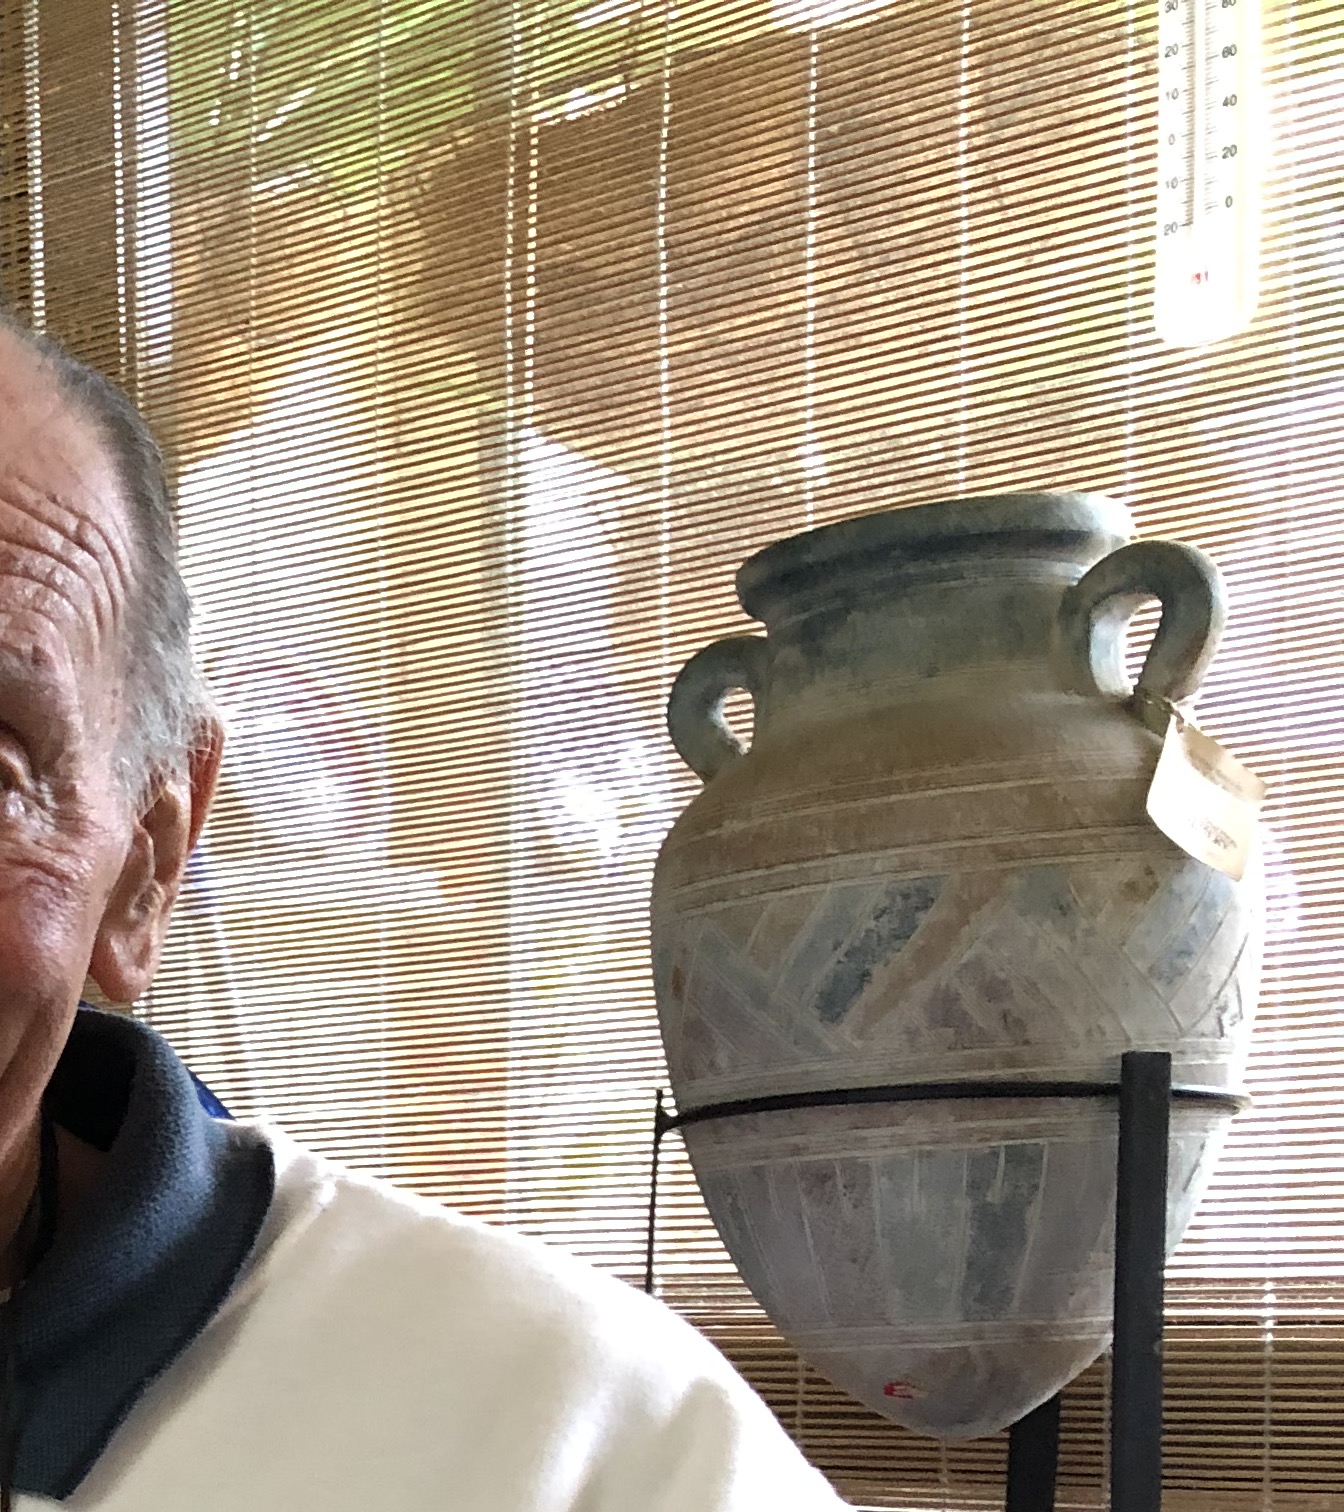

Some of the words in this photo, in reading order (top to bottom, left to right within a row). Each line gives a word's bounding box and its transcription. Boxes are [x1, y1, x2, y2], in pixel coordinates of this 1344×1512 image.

[1165, 0, 1179, 13] 30
[1164, 43, 1179, 58] 20
[1222, 44, 1237, 58] 60
[1166, 88, 1179, 101] 10
[1222, 94, 1237, 107] 40
[1168, 133, 1176, 146] 0
[1222, 144, 1238, 159] 20
[1165, 176, 1179, 190] 10
[1225, 195, 1234, 208] 0
[1164, 221, 1178, 236] 20
